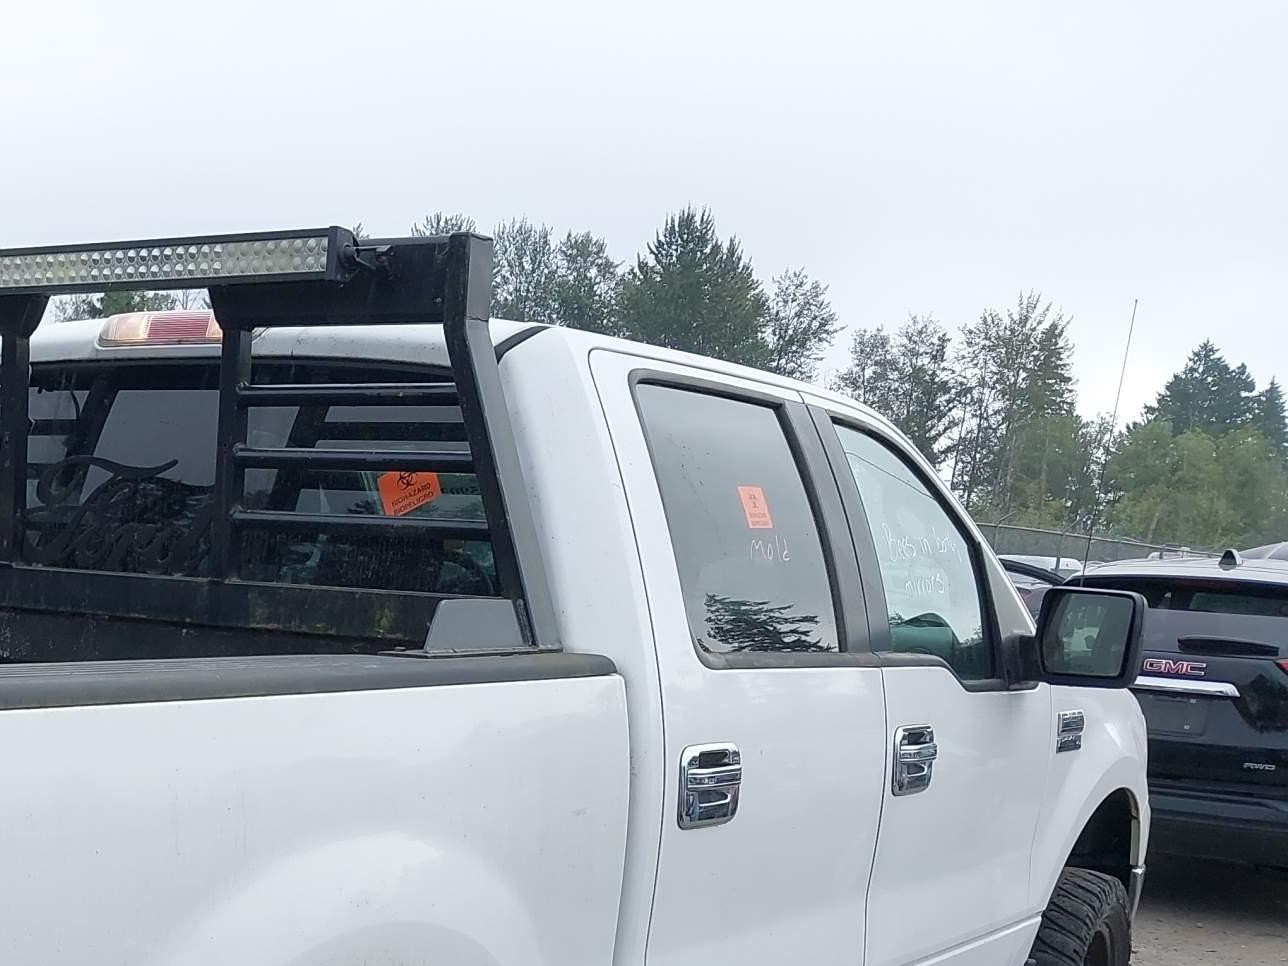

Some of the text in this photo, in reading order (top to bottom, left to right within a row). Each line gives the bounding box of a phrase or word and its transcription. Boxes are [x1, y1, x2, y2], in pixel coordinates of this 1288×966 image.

[392, 482, 431, 507] BIOHAZARD
[750, 535, 791, 561] Mold
[1143, 658, 1207, 676] GMC
